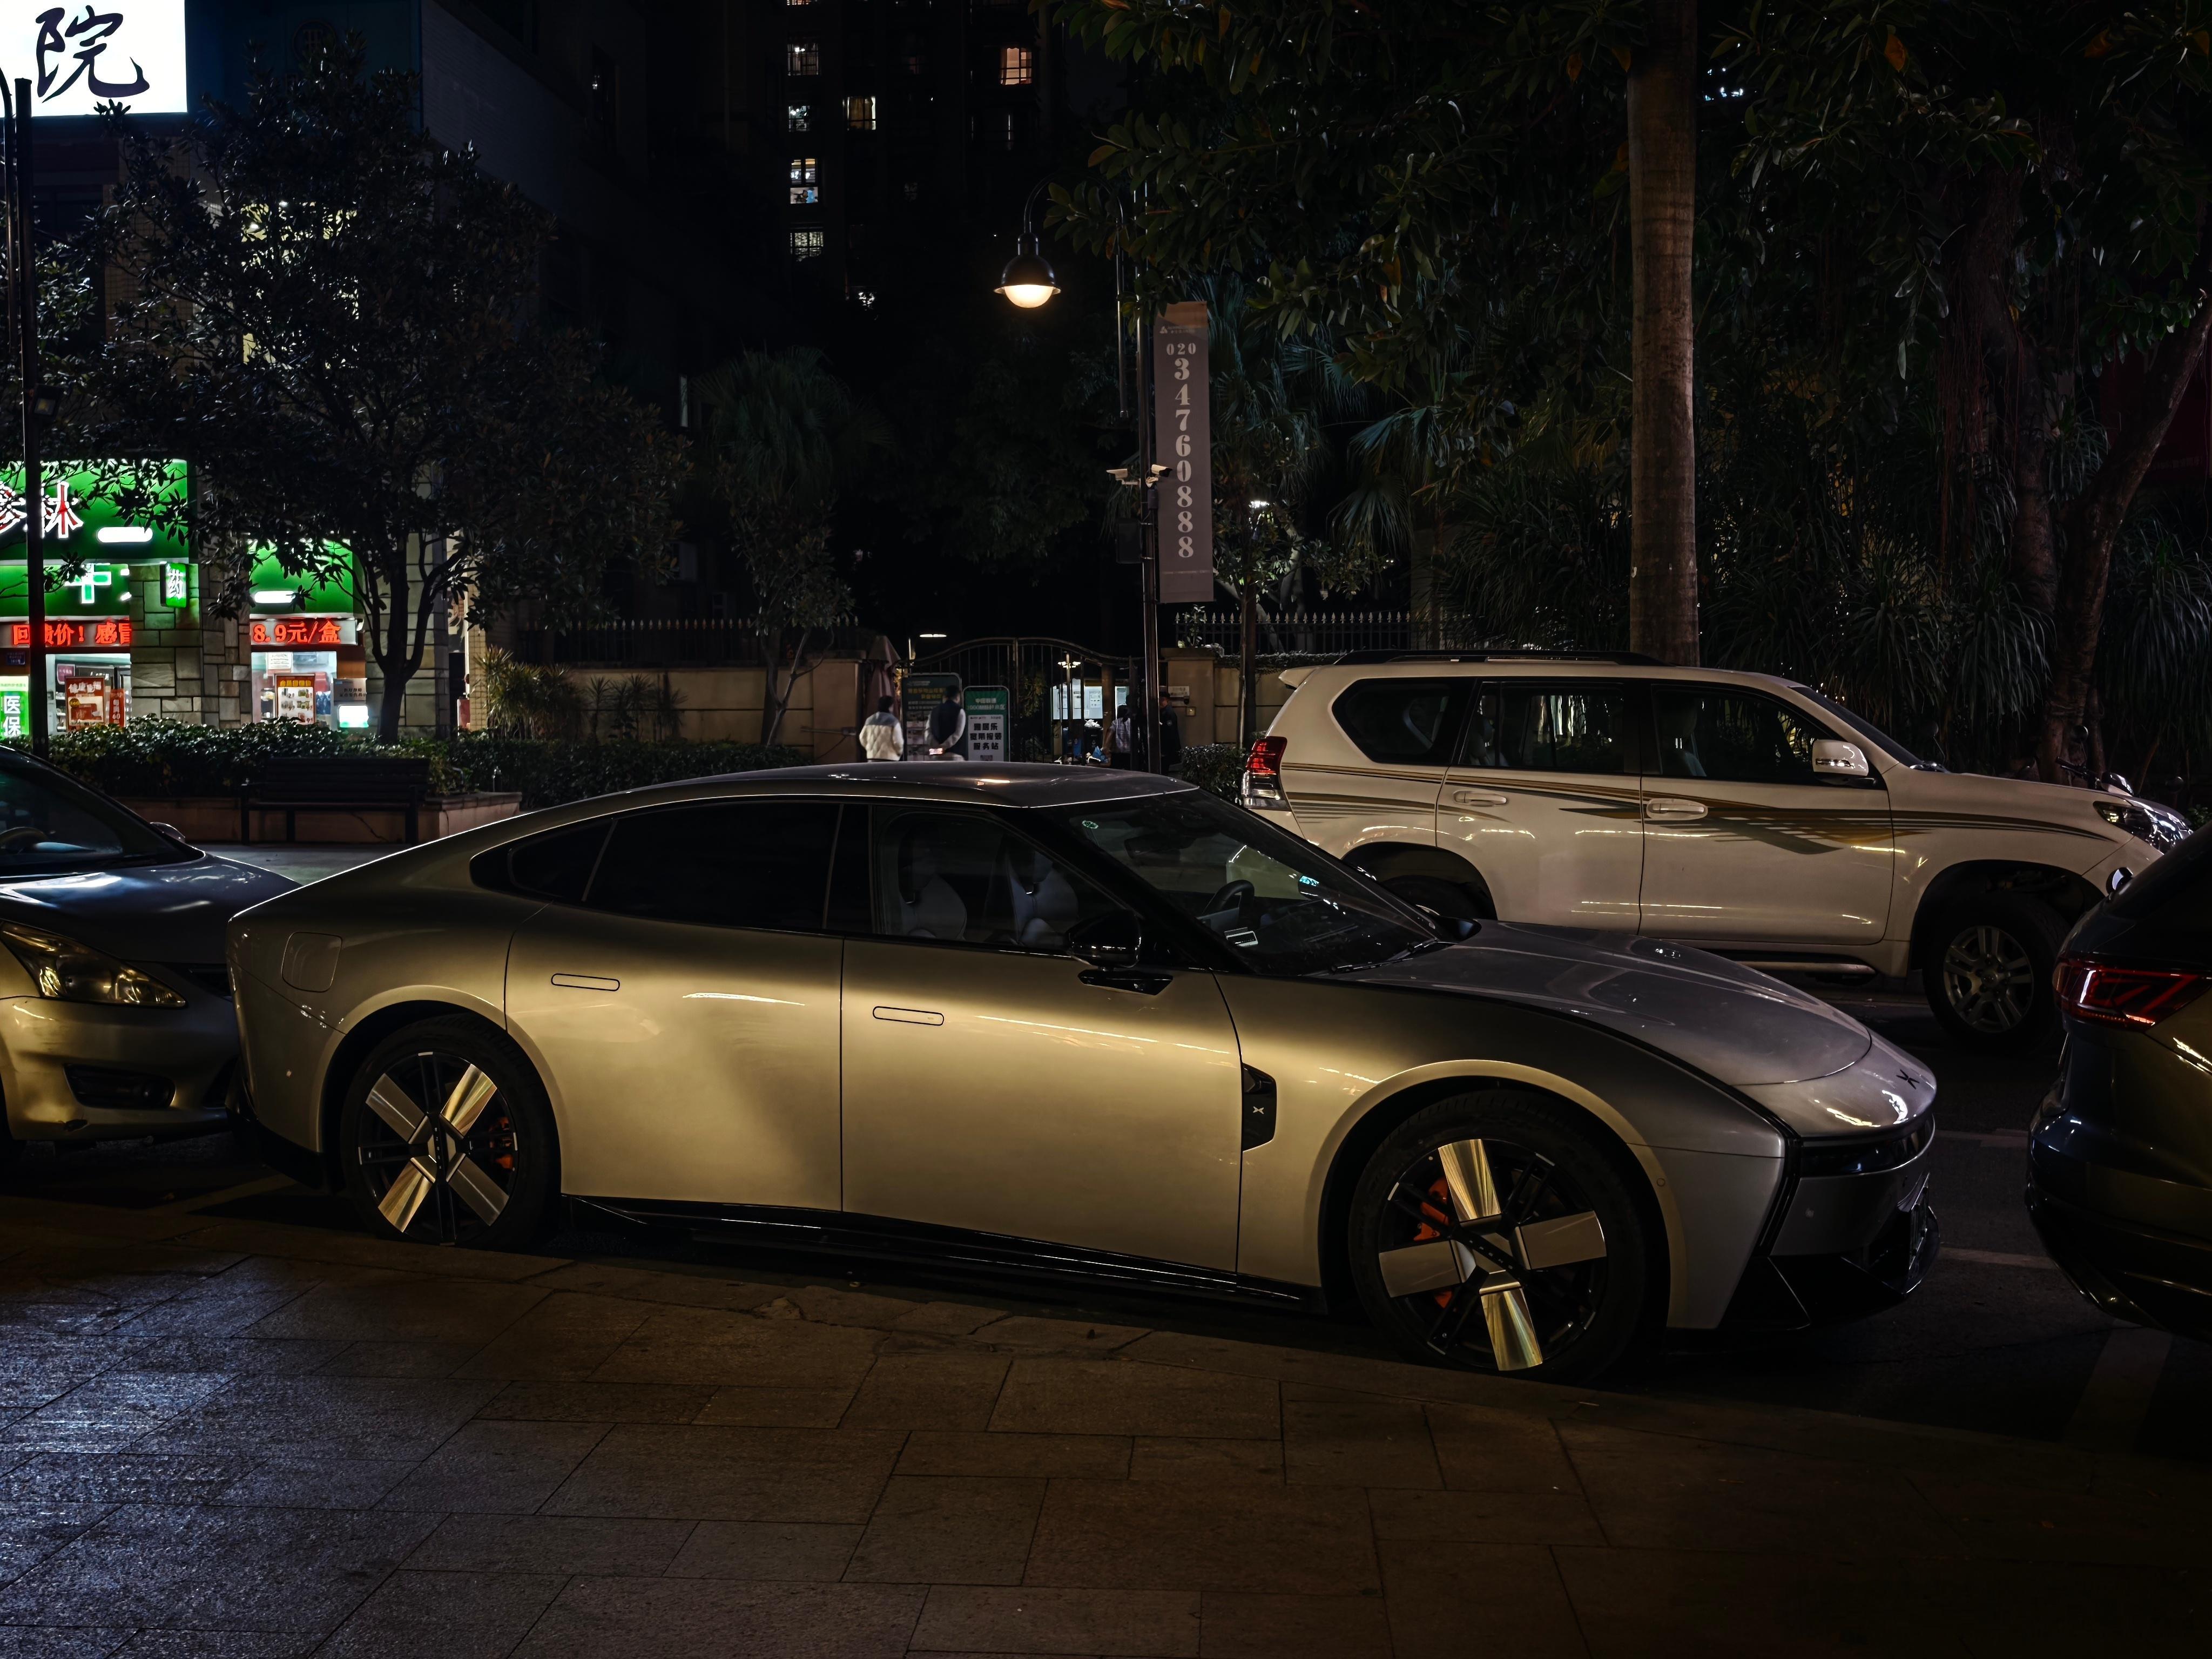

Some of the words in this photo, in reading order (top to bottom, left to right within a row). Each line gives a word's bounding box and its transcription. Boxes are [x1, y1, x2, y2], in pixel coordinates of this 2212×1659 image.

[36, 4, 150, 103] 院
[1166, 342, 1196, 356] 020
[1174, 358, 1194, 558] 34760888
[168, 569, 184, 600] 药
[3, 695, 22, 737] 医保
